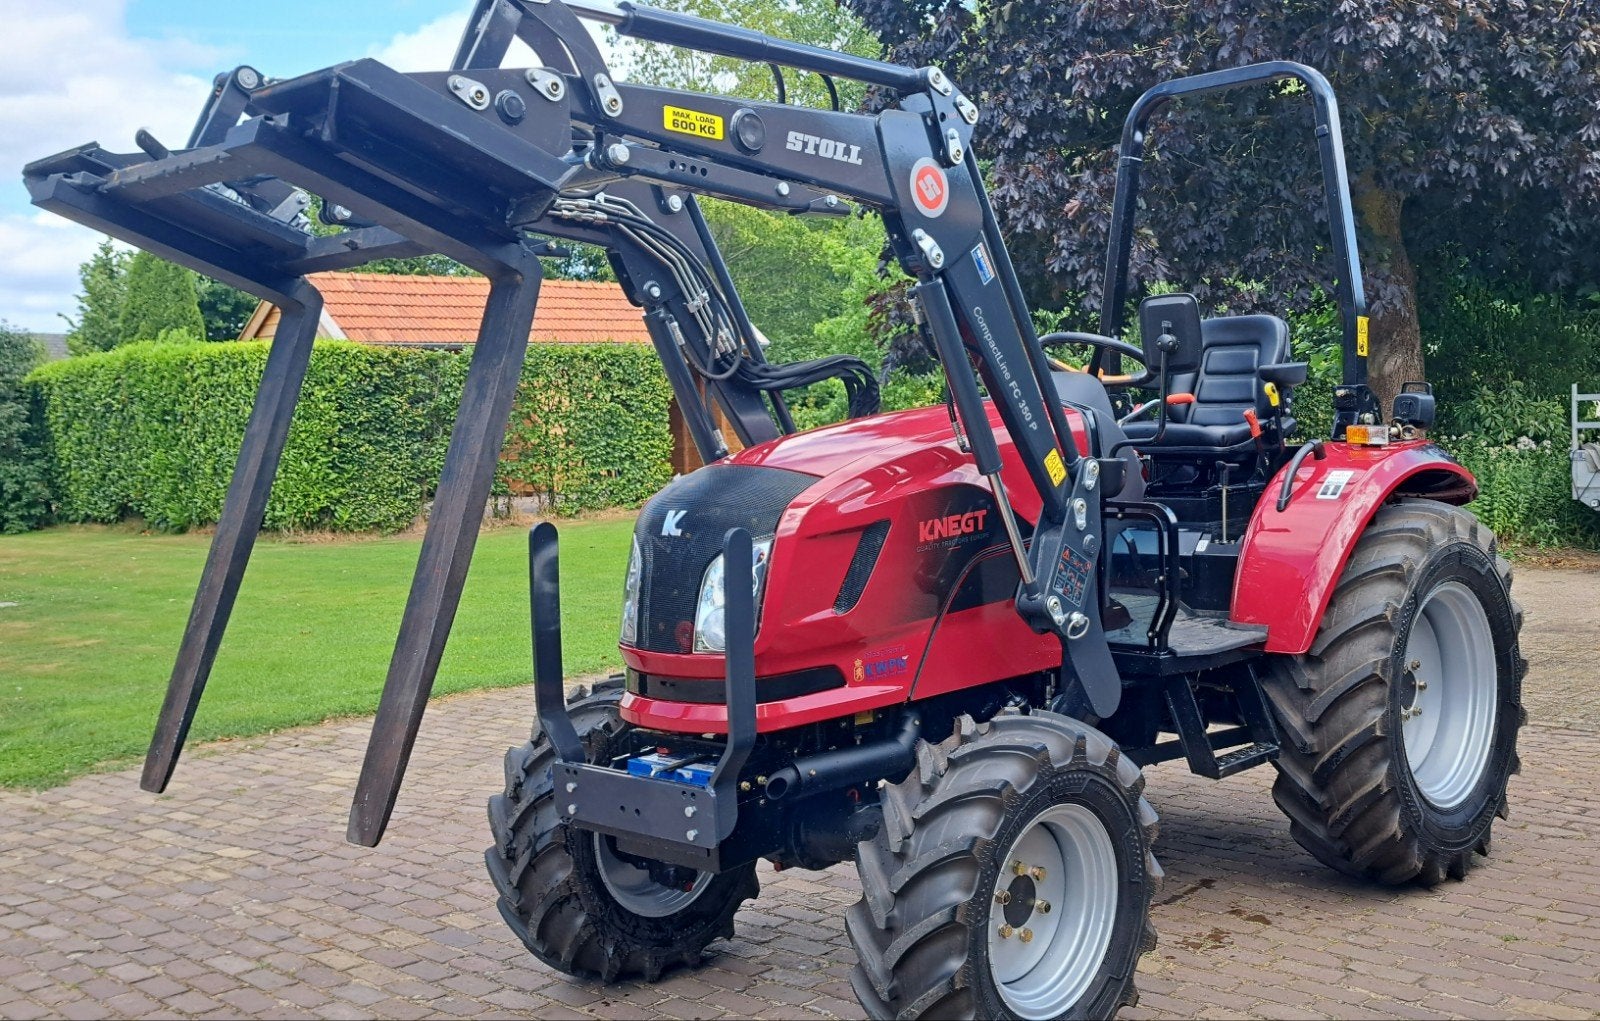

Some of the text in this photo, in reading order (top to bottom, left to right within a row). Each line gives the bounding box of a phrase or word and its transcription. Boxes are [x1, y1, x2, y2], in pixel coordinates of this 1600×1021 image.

[672, 110, 716, 125] MAX. LOAD
[672, 119, 716, 136] 600 KG
[785, 130, 863, 166] STOLL
[973, 306, 1039, 431] CompactLine FC 350 P
[661, 510, 687, 536] K
[919, 509, 987, 542] KNEGT
